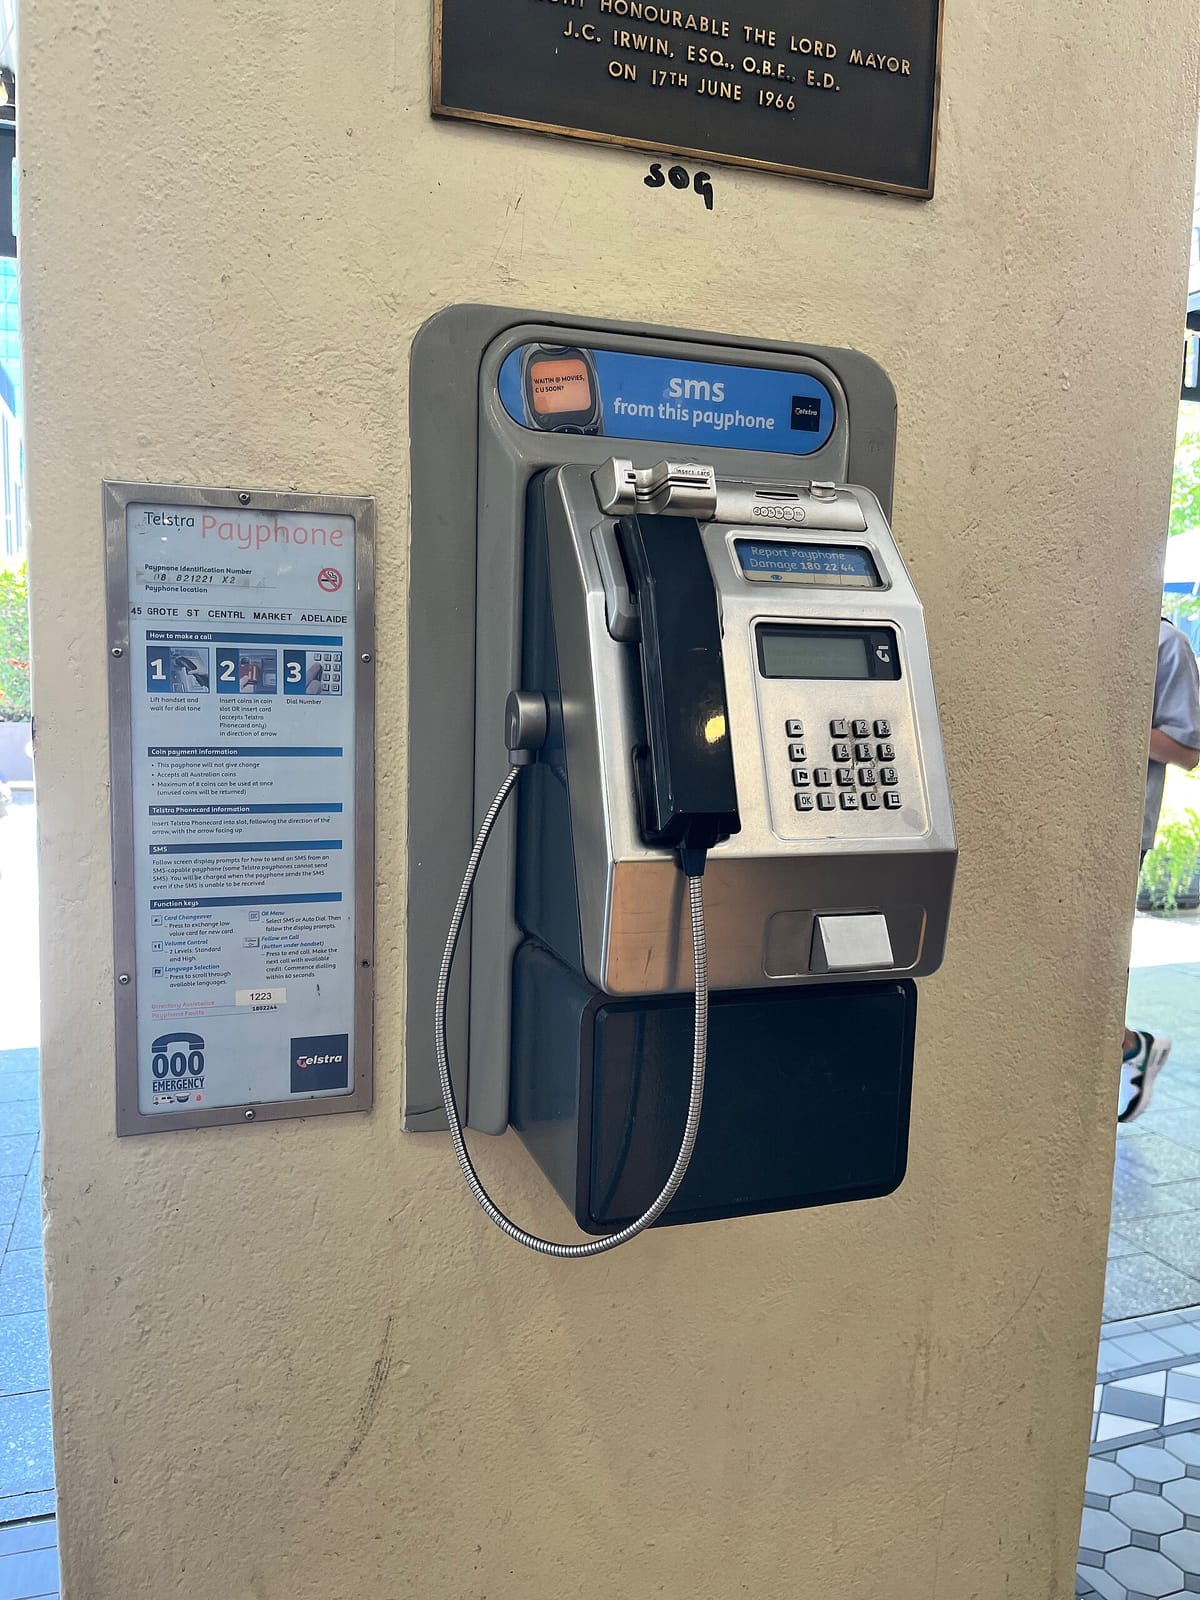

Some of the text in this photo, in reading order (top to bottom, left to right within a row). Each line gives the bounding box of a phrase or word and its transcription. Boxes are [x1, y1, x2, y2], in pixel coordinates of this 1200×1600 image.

[600, 0, 912, 77] HONOURABLE THE LORD MAYOR
[563, 20, 602, 43] J.C.
[613, 29, 675, 58] IRWIN,
[687, 45, 736, 72] ESQ.,
[806, 69, 841, 92] E.D.
[608, 59, 797, 112] ON 17TH JUNE 1966
[533, 376, 555, 385] WAITIN
[561, 374, 585, 382] MOVIES,
[668, 375, 725, 403] sms
[613, 398, 776, 431] from this payphone
[143, 511, 344, 550] Telstra Payphone
[750, 546, 846, 562] Report Payphone
[144, 564, 179, 574] Payphone
[750, 558, 856, 572] Damage 180 22 44
[222, 576, 236, 584] X2
[145, 585, 179, 594] Payphone
[130, 607, 348, 624] 45 GROTE ST CENTRL MARKET ADELAIDE
[166, 632, 174, 640] to
[174, 632, 193, 640] make
[200, 632, 212, 640] call
[150, 659, 166, 680] 1
[219, 660, 236, 682] 2
[286, 662, 302, 683] 3
[838, 721, 844, 729] 1
[861, 721, 866, 730] 2
[881, 721, 888, 729] 3
[841, 745, 847, 753] 4
[864, 745, 869, 753] 5
[885, 744, 891, 752] 6
[844, 770, 850, 778] 7
[867, 769, 873, 778] 8
[888, 769, 894, 777] 9
[801, 797, 811, 805] OK
[183, 900, 199, 908] keys
[249, 992, 272, 1001] 1223
[151, 1050, 205, 1078] 000
[296, 1054, 343, 1069] Telstra
[152, 1077, 205, 1092] EMERGENCY
